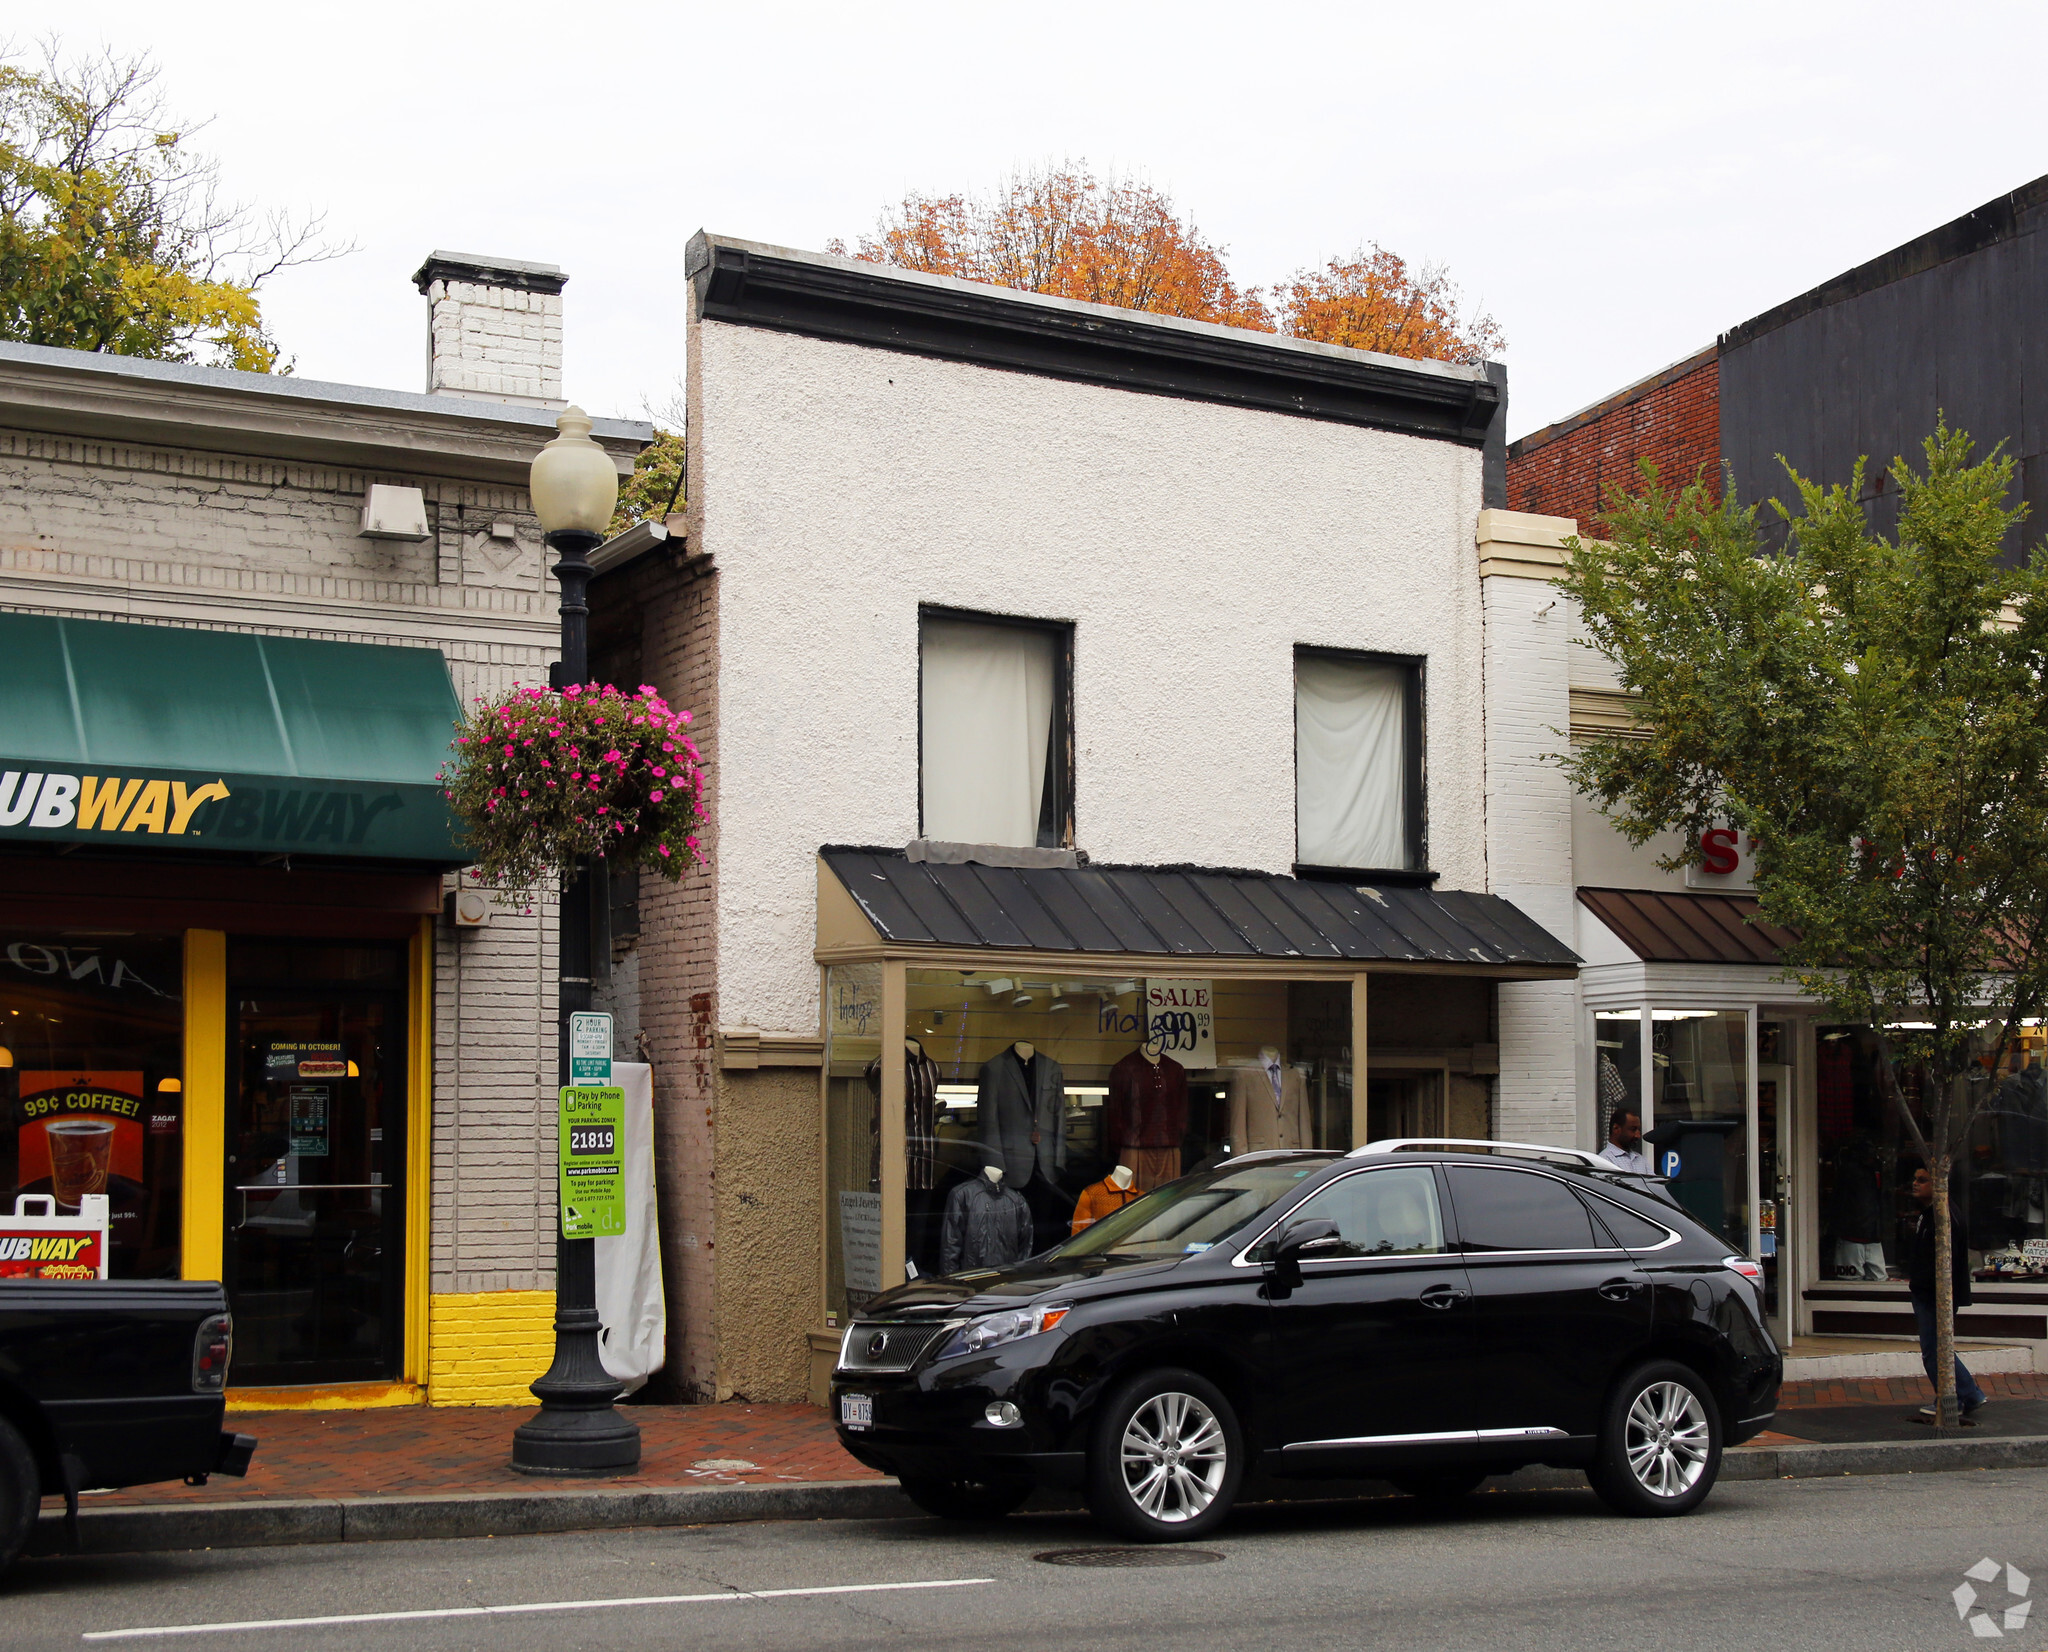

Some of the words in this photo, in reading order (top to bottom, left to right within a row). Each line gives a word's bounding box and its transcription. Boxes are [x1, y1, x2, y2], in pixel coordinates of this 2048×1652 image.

[1150, 987, 1210, 1008] SALE
[576, 1019, 583, 1032] 2
[585, 1018, 602, 1027] HOUR
[271, 1042, 298, 1051] COMING
[299, 1042, 307, 1051] IN
[308, 1042, 341, 1051] OCTOBER!
[577, 1091, 590, 1101] Pay
[590, 1091, 599, 1101] by
[600, 1091, 620, 1100] Phone
[66, 1092, 140, 1117] COFFEE!
[577, 1101, 602, 1111] Parking
[571, 1131, 614, 1149] 21819
[567, 1167, 618, 1176] www.parkmobile.com
[1666, 1151, 1680, 1177] P
[565, 1222, 593, 1231] Parkmobile
[0, 1235, 94, 1261] UBWAY
[843, 1402, 852, 1420] DY
